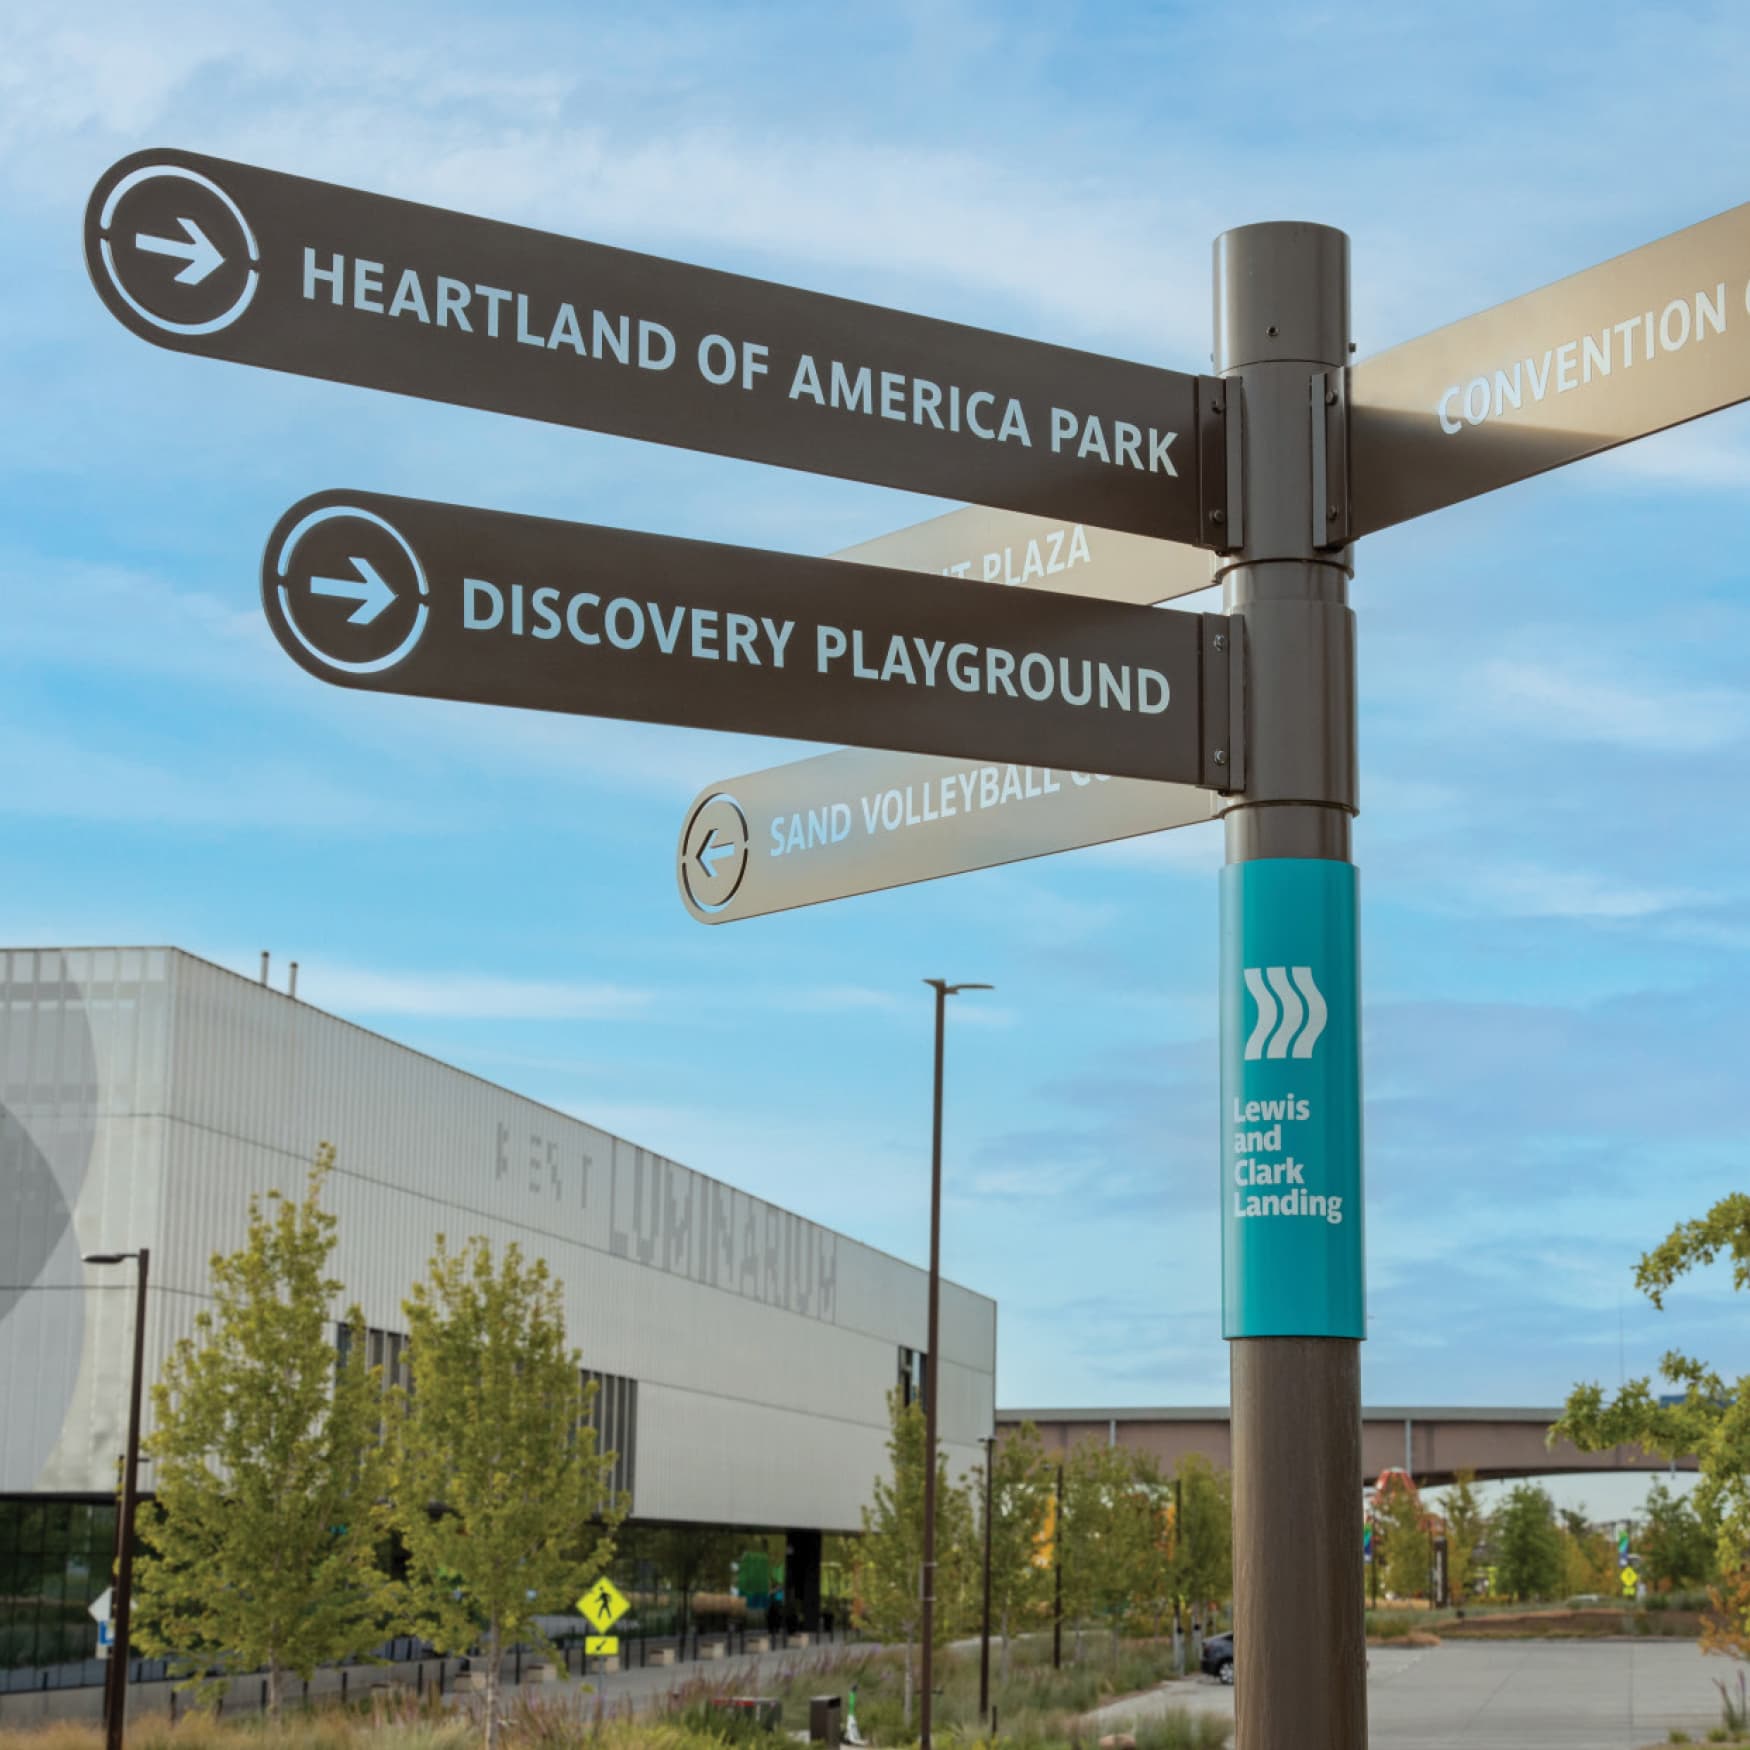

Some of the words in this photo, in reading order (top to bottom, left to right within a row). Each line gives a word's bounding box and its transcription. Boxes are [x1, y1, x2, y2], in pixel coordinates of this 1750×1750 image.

[303, 246, 677, 374] HEARTLAND
[697, 334, 769, 390] OF
[788, 354, 1032, 447] AMERICA
[1051, 407, 1179, 478] PARK
[1437, 282, 1726, 436] CONVENTION
[983, 522, 1092, 587] PLAZA
[463, 578, 795, 669] DISCOVERY
[817, 625, 1171, 714] PLAYGROUND
[769, 803, 851, 857] SAND
[861, 764, 1061, 835] VOLLEYBALL
[1232, 1093, 1311, 1123] Lewis
[1233, 1124, 1282, 1153] and
[1233, 1156, 1304, 1187] Clark
[1232, 1188, 1343, 1225] Landing
